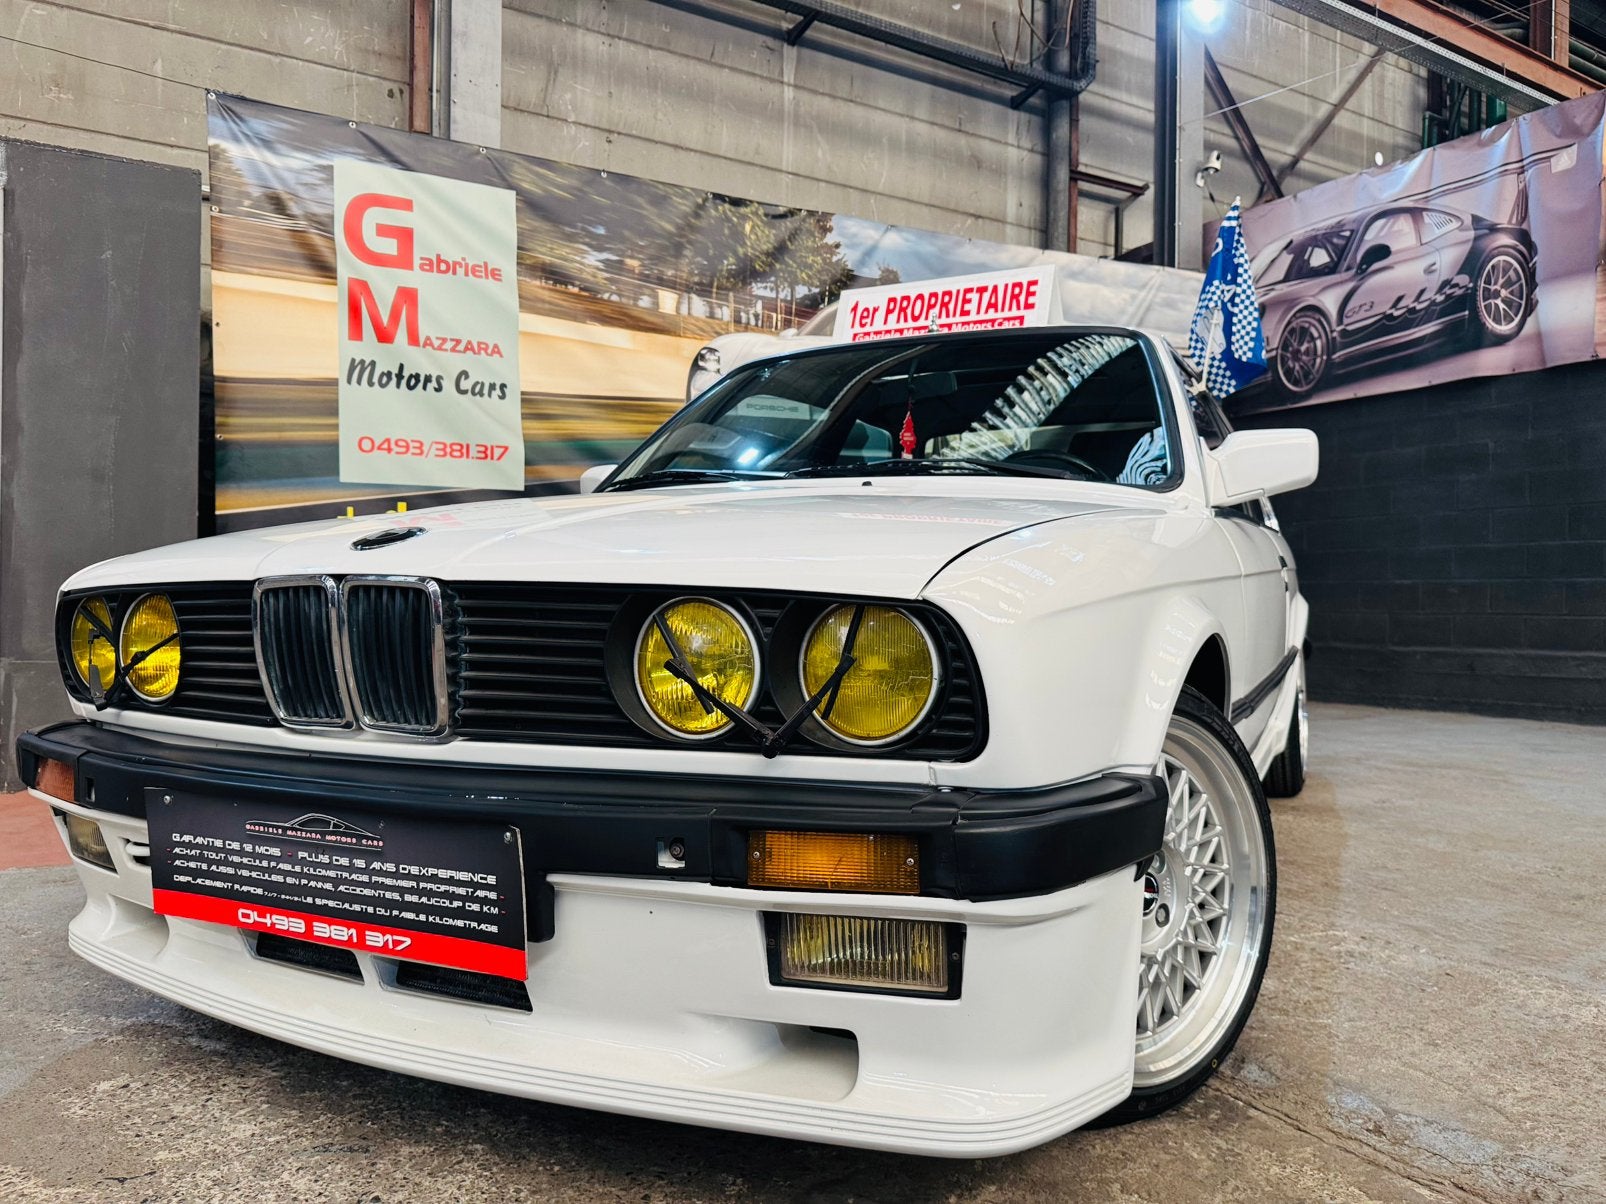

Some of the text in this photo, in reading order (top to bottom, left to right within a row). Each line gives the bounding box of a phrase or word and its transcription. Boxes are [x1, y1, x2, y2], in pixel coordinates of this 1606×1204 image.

[343, 192, 503, 282] Gabriele
[347, 277, 503, 358] MAZZARA
[850, 279, 1039, 329] 1er PROPRIETAIRE
[994, 318, 1020, 329] Cars
[1344, 300, 1375, 319] GT3
[347, 357, 508, 400] Motors Cars
[357, 435, 510, 461] 0493/381.317
[172, 833, 223, 848] GARANTIE
[225, 840, 241, 850] DE
[242, 843, 253, 852] 12
[256, 845, 281, 856] MOIS
[298, 851, 330, 864] PLUS
[332, 856, 350, 866] DE
[352, 858, 366, 868] 15
[370, 861, 396, 872] ANS
[399, 864, 497, 885] D'EXPERIENCE
[325, 834, 357, 844] MOTORS
[361, 838, 384, 847] CARS
[173, 847, 201, 856] ACHAT
[202, 851, 226, 860] TOUT
[227, 854, 269, 867] VEHICULE
[303, 866, 369, 882] KILOMETRAGE
[372, 876, 417, 888] PREMIER
[419, 882, 498, 900] PROPRIETAIRE
[173, 859, 208, 870] ACHETE
[210, 865, 235, 875] AUSSI
[236, 868, 285, 883] VEHICULES
[286, 876, 299, 885] EN
[404, 893, 463, 908] BEAUCOUP
[465, 902, 481, 911] DE
[482, 904, 499, 914] KM
[173, 874, 232, 889] DEPLACEMENT
[234, 884, 264, 895] RAPIDE
[302, 895, 313, 904] LE
[376, 907, 390, 916] DU
[392, 909, 426, 921] FAIBLE
[428, 915, 499, 933] KILOMETRAGE
[237, 907, 412, 951] 0493 381 317
